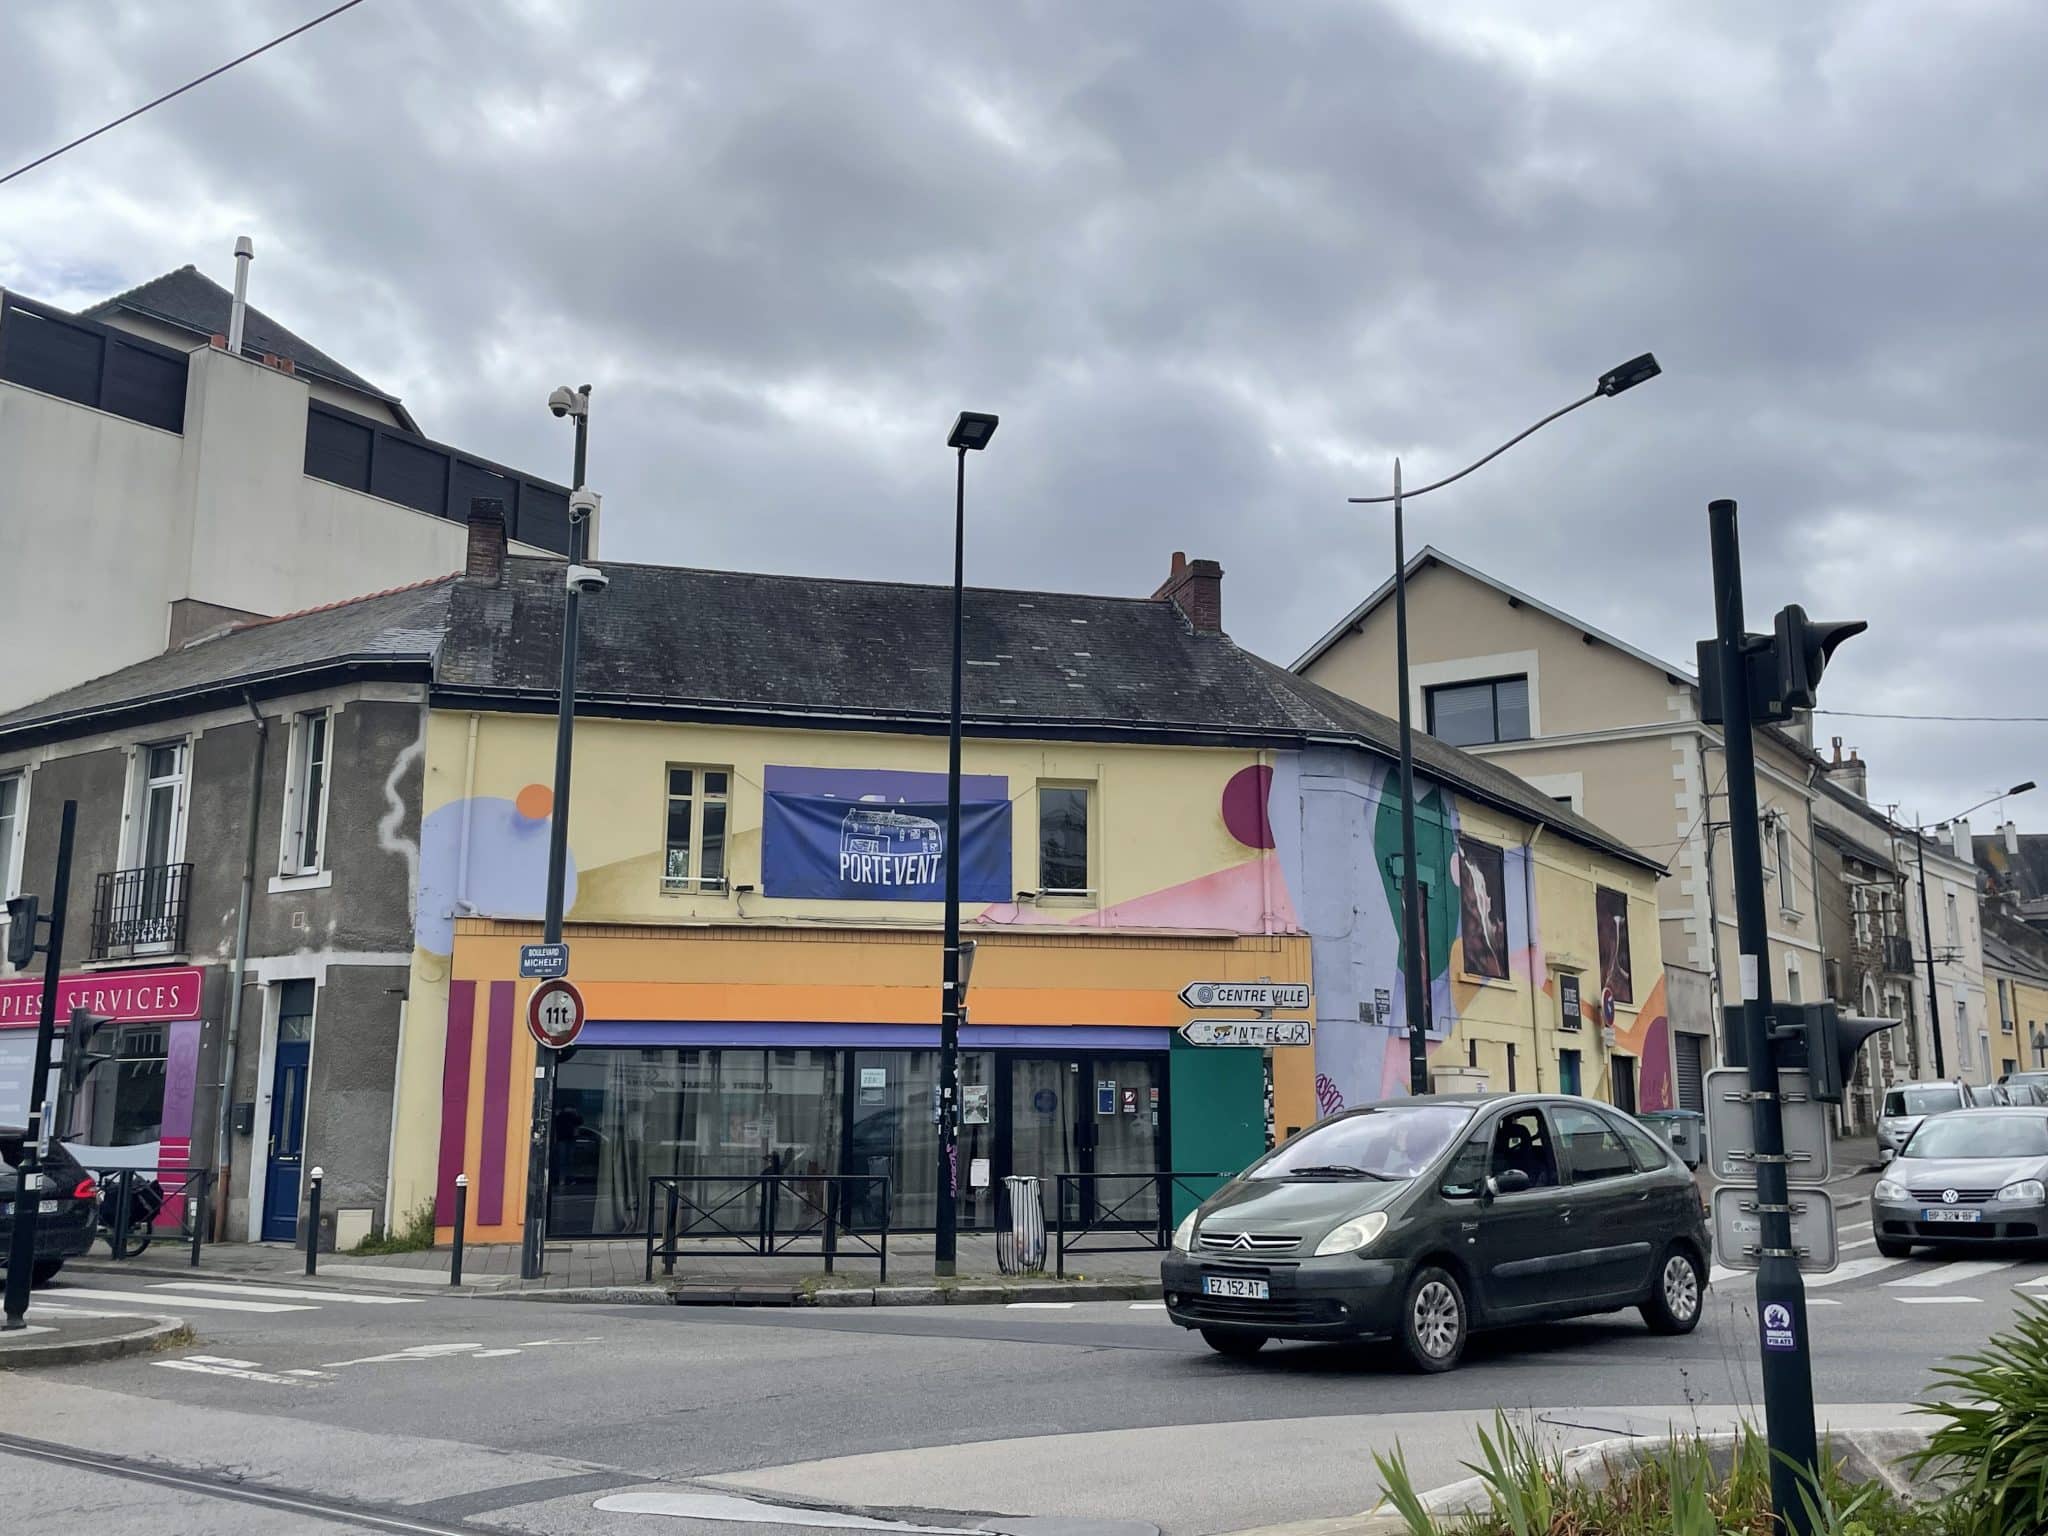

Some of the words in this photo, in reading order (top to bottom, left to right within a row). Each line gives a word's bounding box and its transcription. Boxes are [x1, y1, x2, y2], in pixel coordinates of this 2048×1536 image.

[528, 948, 560, 957] BOULEVARD
[524, 958, 562, 967] MICHELET
[67, 985, 179, 1013] SERVICES
[1218, 989, 1267, 1002] CENTRE
[1272, 989, 1304, 1002] VILLE
[546, 1006, 569, 1024] 11t
